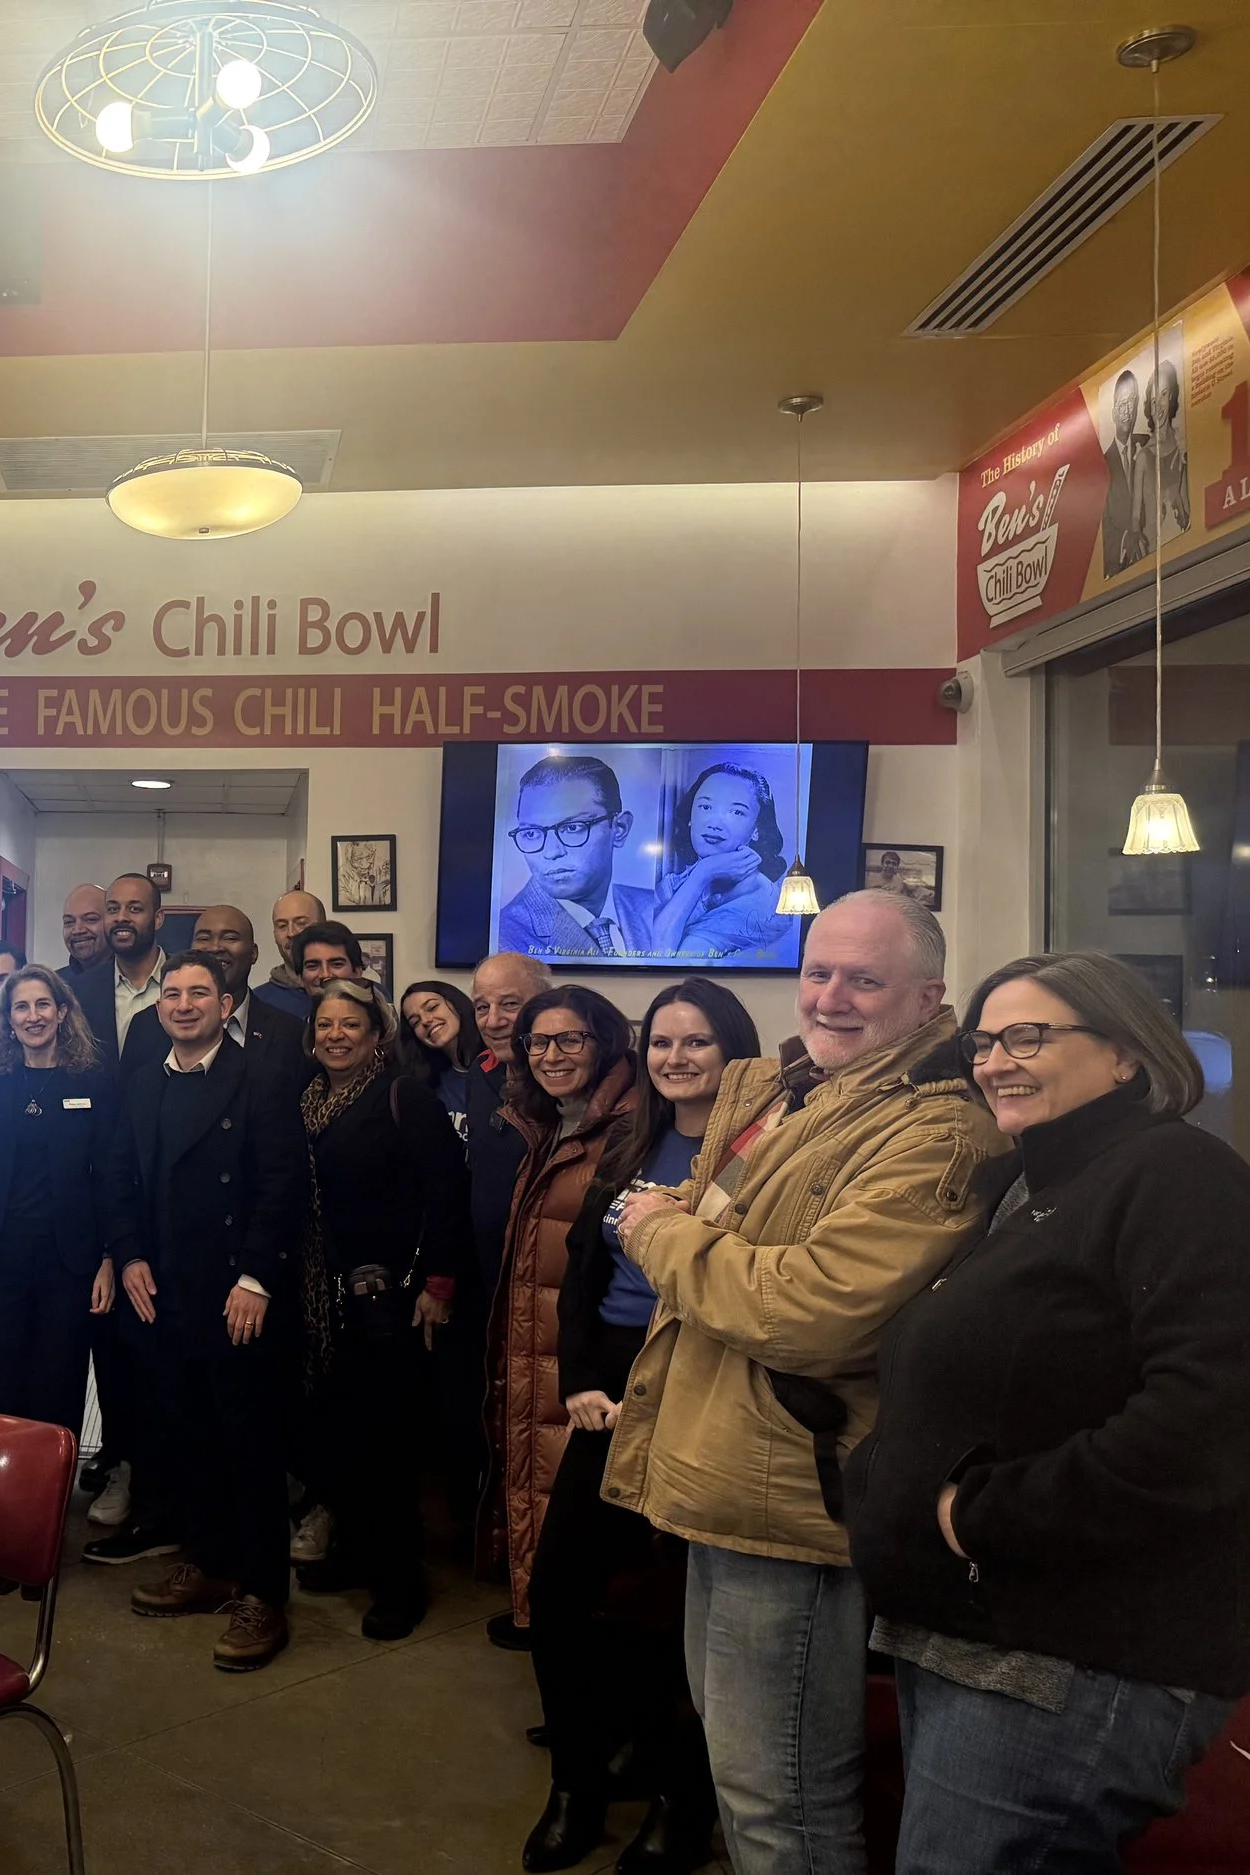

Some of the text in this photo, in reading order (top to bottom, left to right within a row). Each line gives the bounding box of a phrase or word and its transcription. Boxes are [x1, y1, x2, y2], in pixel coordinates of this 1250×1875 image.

[981, 422, 1061, 488] The History of
[978, 480, 1044, 557] Ben's
[985, 545, 1048, 603] Chili Bowl
[152, 594, 277, 658] Chili
[297, 592, 441, 655] Bowl
[36, 687, 214, 736] FAMOUS
[234, 686, 341, 736] CHILI
[372, 683, 665, 736] HALF-SMOKE
